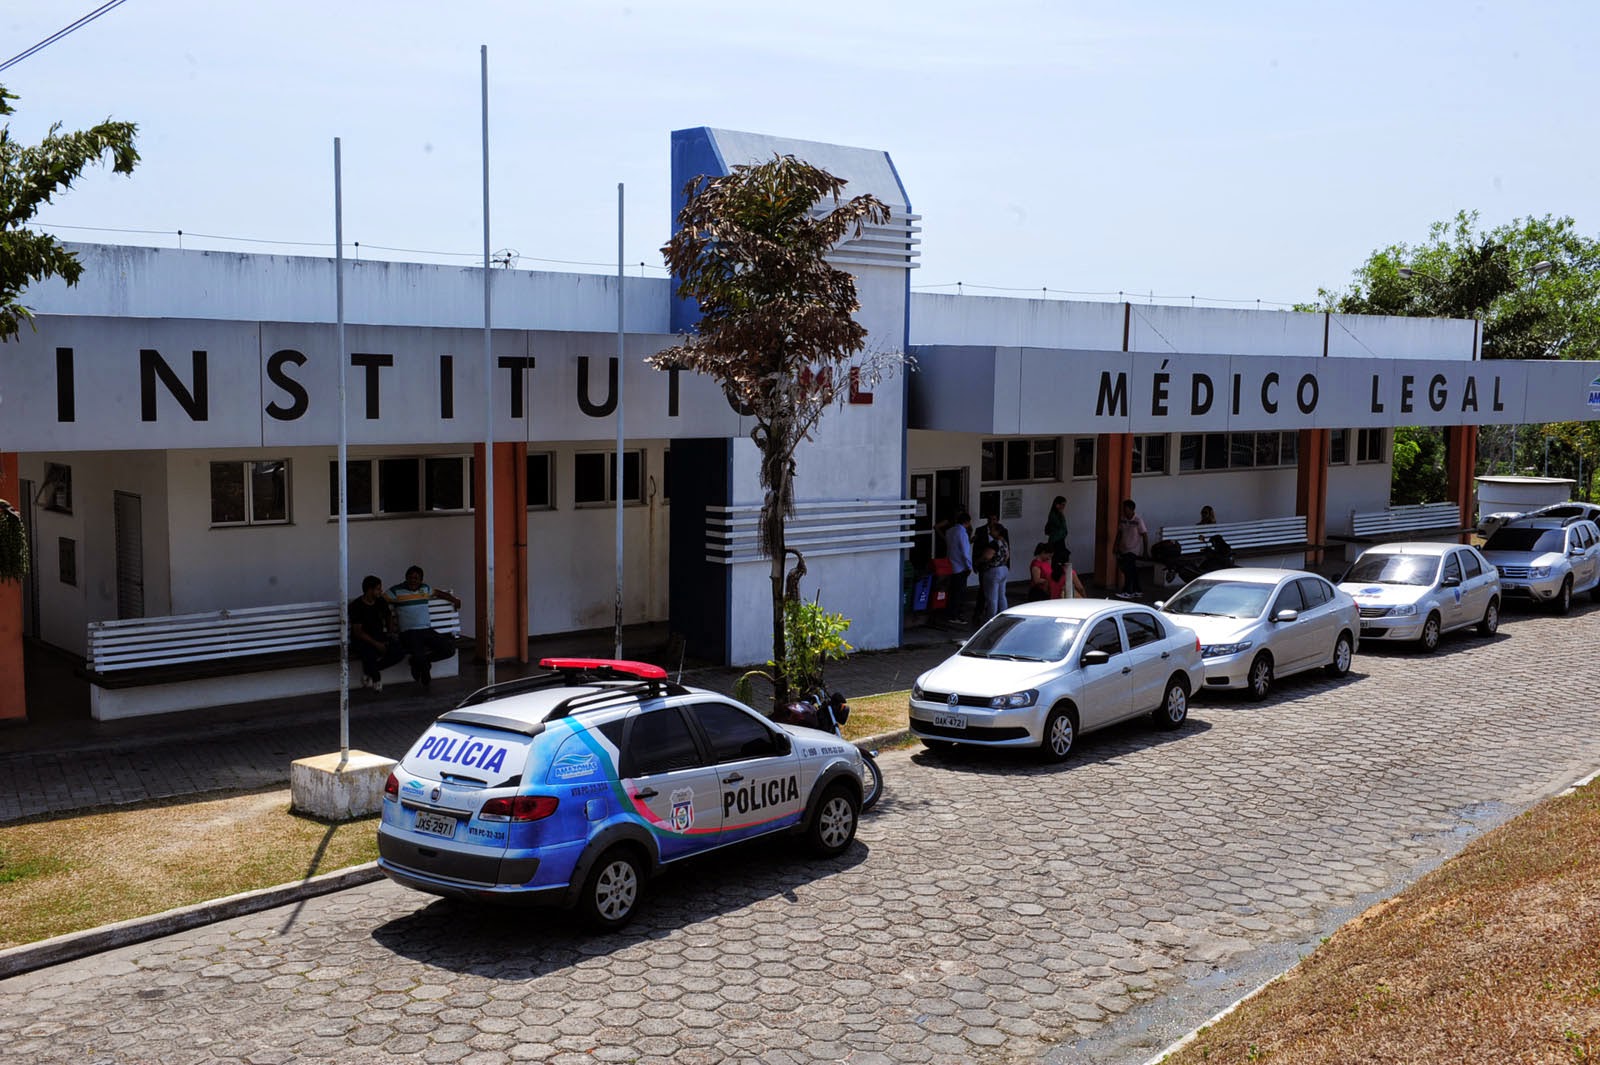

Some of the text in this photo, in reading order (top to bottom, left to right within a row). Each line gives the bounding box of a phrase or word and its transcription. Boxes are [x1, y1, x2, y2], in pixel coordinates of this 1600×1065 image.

[55, 347, 758, 422] INSTITUT
[1096, 359, 1504, 417] MÉDICO LEGAL
[415, 735, 507, 773] POLÍCIA
[555, 762, 599, 777] AMAZONAS
[723, 775, 799, 818] POLÍCIA
